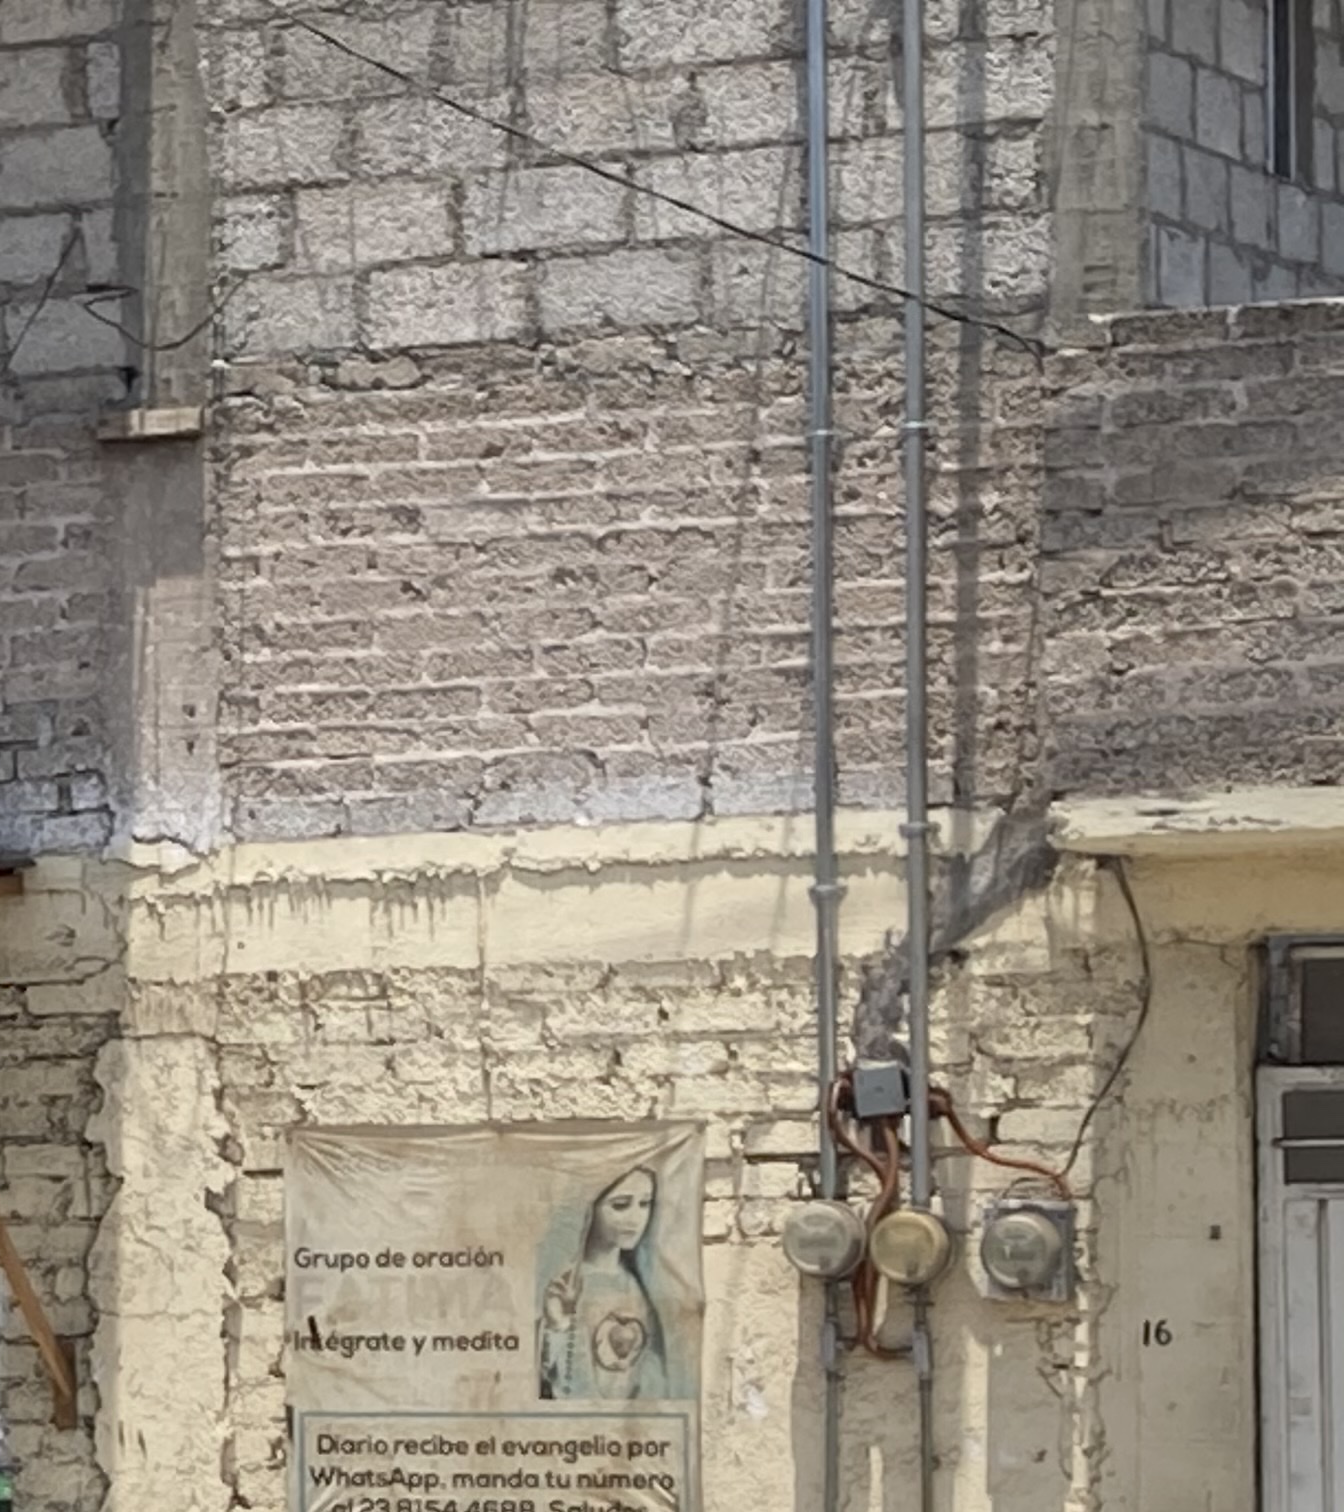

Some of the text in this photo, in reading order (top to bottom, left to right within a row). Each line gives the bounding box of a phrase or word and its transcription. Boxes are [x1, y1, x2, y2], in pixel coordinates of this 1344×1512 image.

[294, 1246, 505, 1272] Grupo de oración
[294, 1327, 520, 1359] Intégrate y medita
[1143, 1318, 1173, 1347] 16
[317, 1434, 671, 1463] Diario recibe el evangelio por
[453, 1469, 540, 1488] manda
[545, 1471, 571, 1488] tu
[577, 1467, 675, 1490] número
